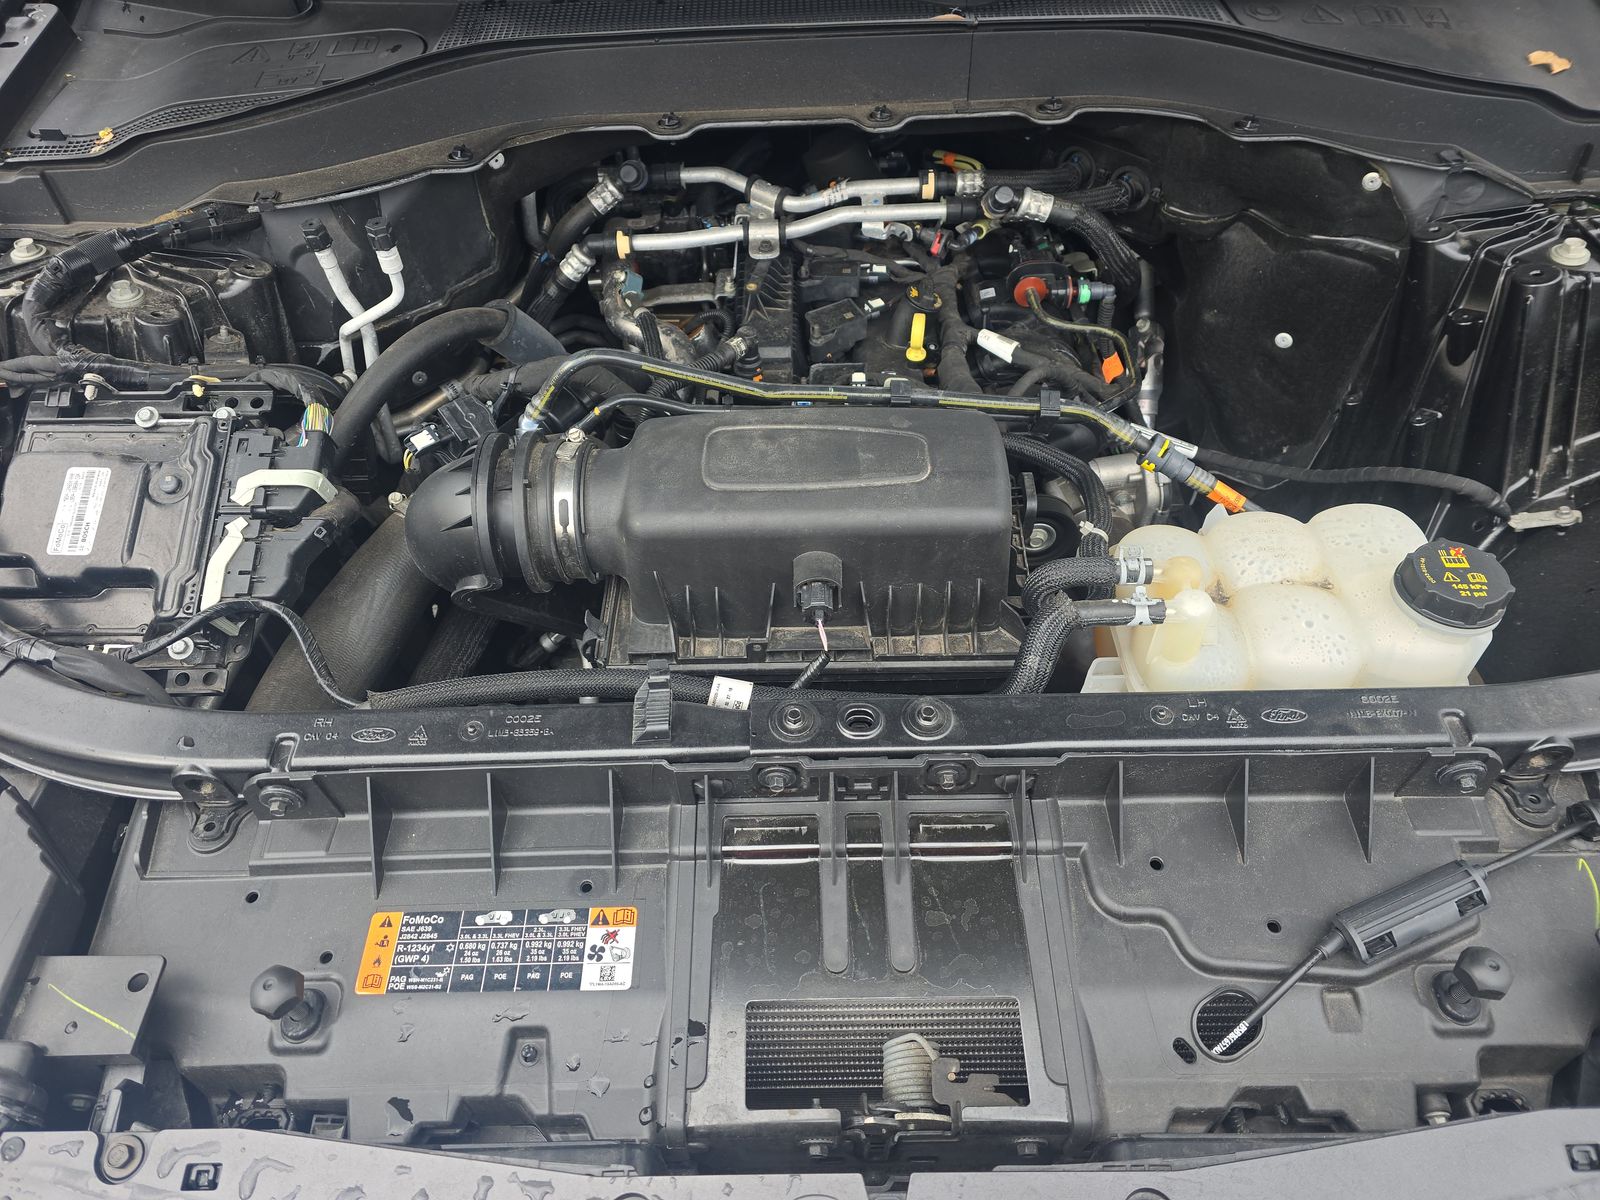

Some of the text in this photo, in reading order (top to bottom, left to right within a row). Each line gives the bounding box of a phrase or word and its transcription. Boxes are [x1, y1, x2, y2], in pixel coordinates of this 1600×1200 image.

[1186, 698, 1208, 707] LH
[314, 718, 334, 728] RH
[403, 915, 444, 924] FoMoCo
[397, 944, 435, 953] R-1234yf
[478, 943, 486, 951] kg
[576, 941, 583, 949] kg
[394, 955, 429, 964] (GWP 4)
